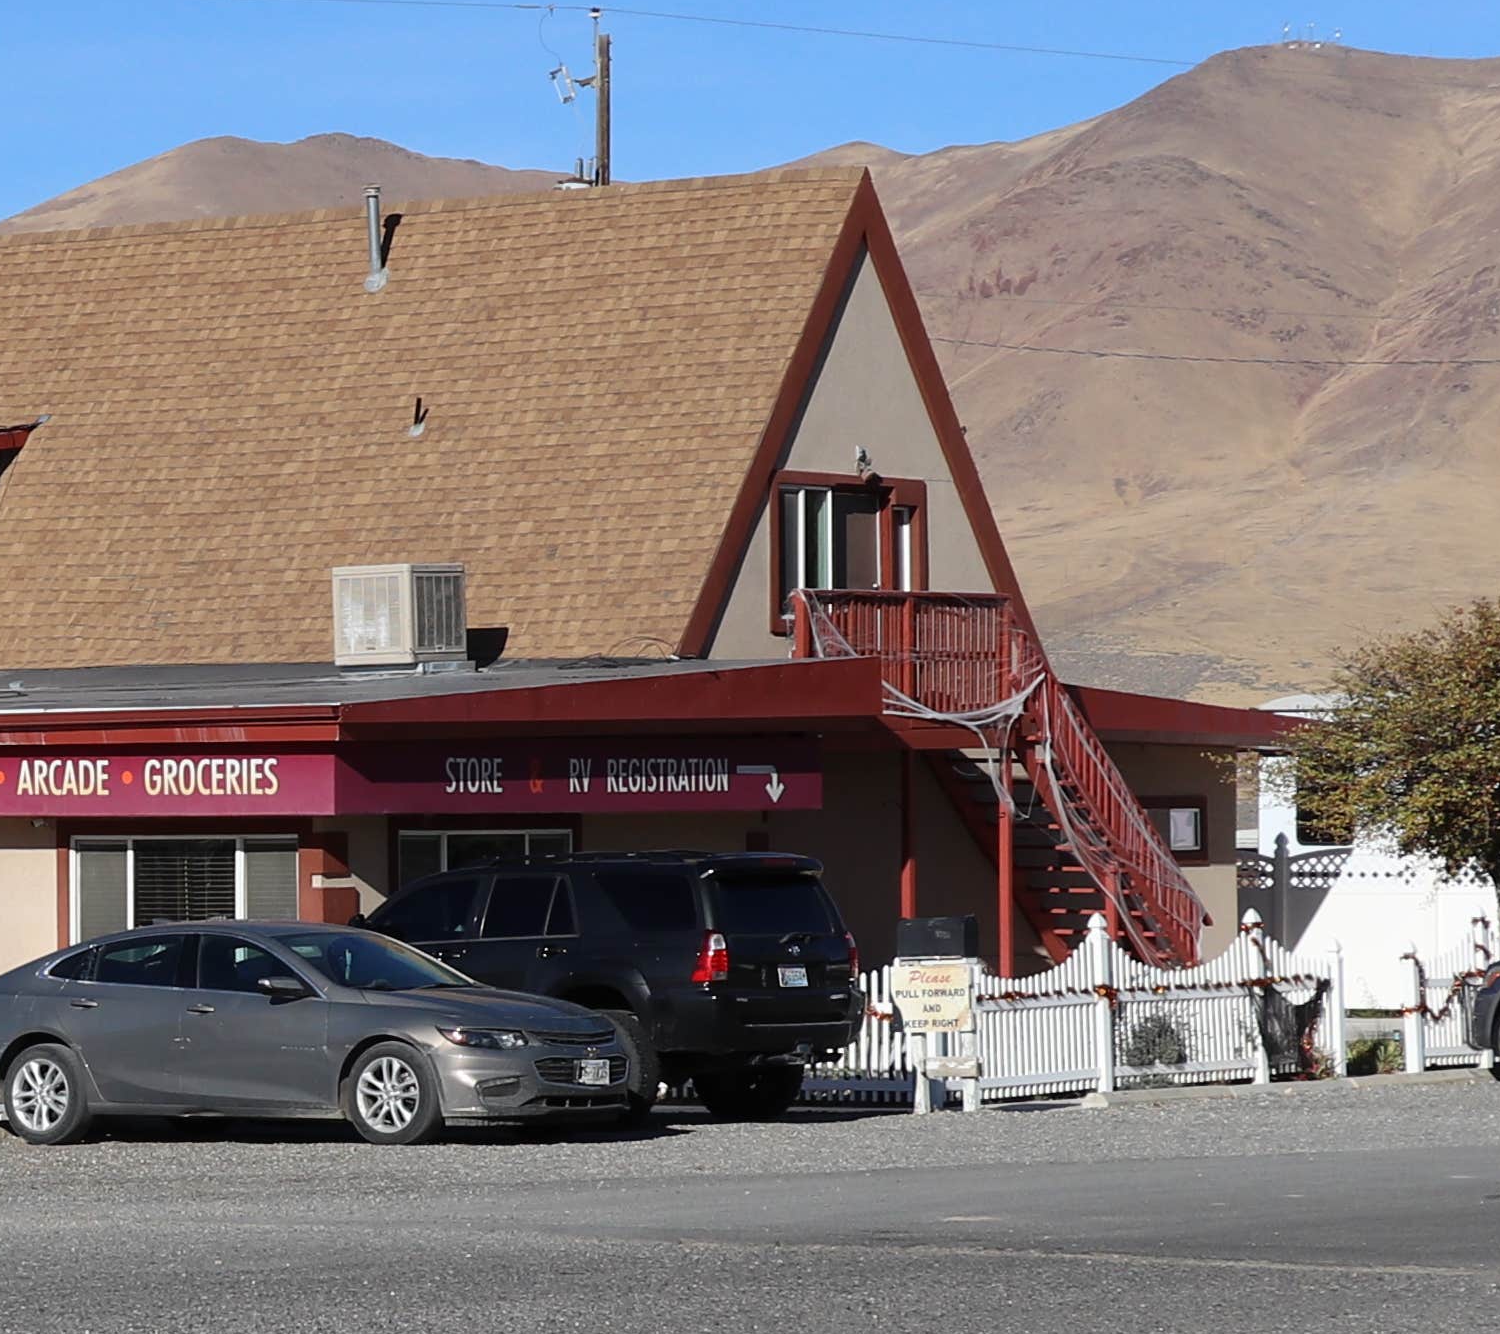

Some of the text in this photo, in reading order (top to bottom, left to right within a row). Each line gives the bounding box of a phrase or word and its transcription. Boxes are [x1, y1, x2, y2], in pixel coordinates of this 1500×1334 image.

[16, 758, 110, 797] ARCADE
[143, 757, 279, 797] GROCERIES
[445, 757, 729, 794] STORE & RV REGISTRATION
[908, 970, 952, 984] Please
[896, 989, 966, 999] PULL FORWARD
[923, 1004, 942, 1013] AND
[904, 1018, 960, 1028] KEEP RIGHT
